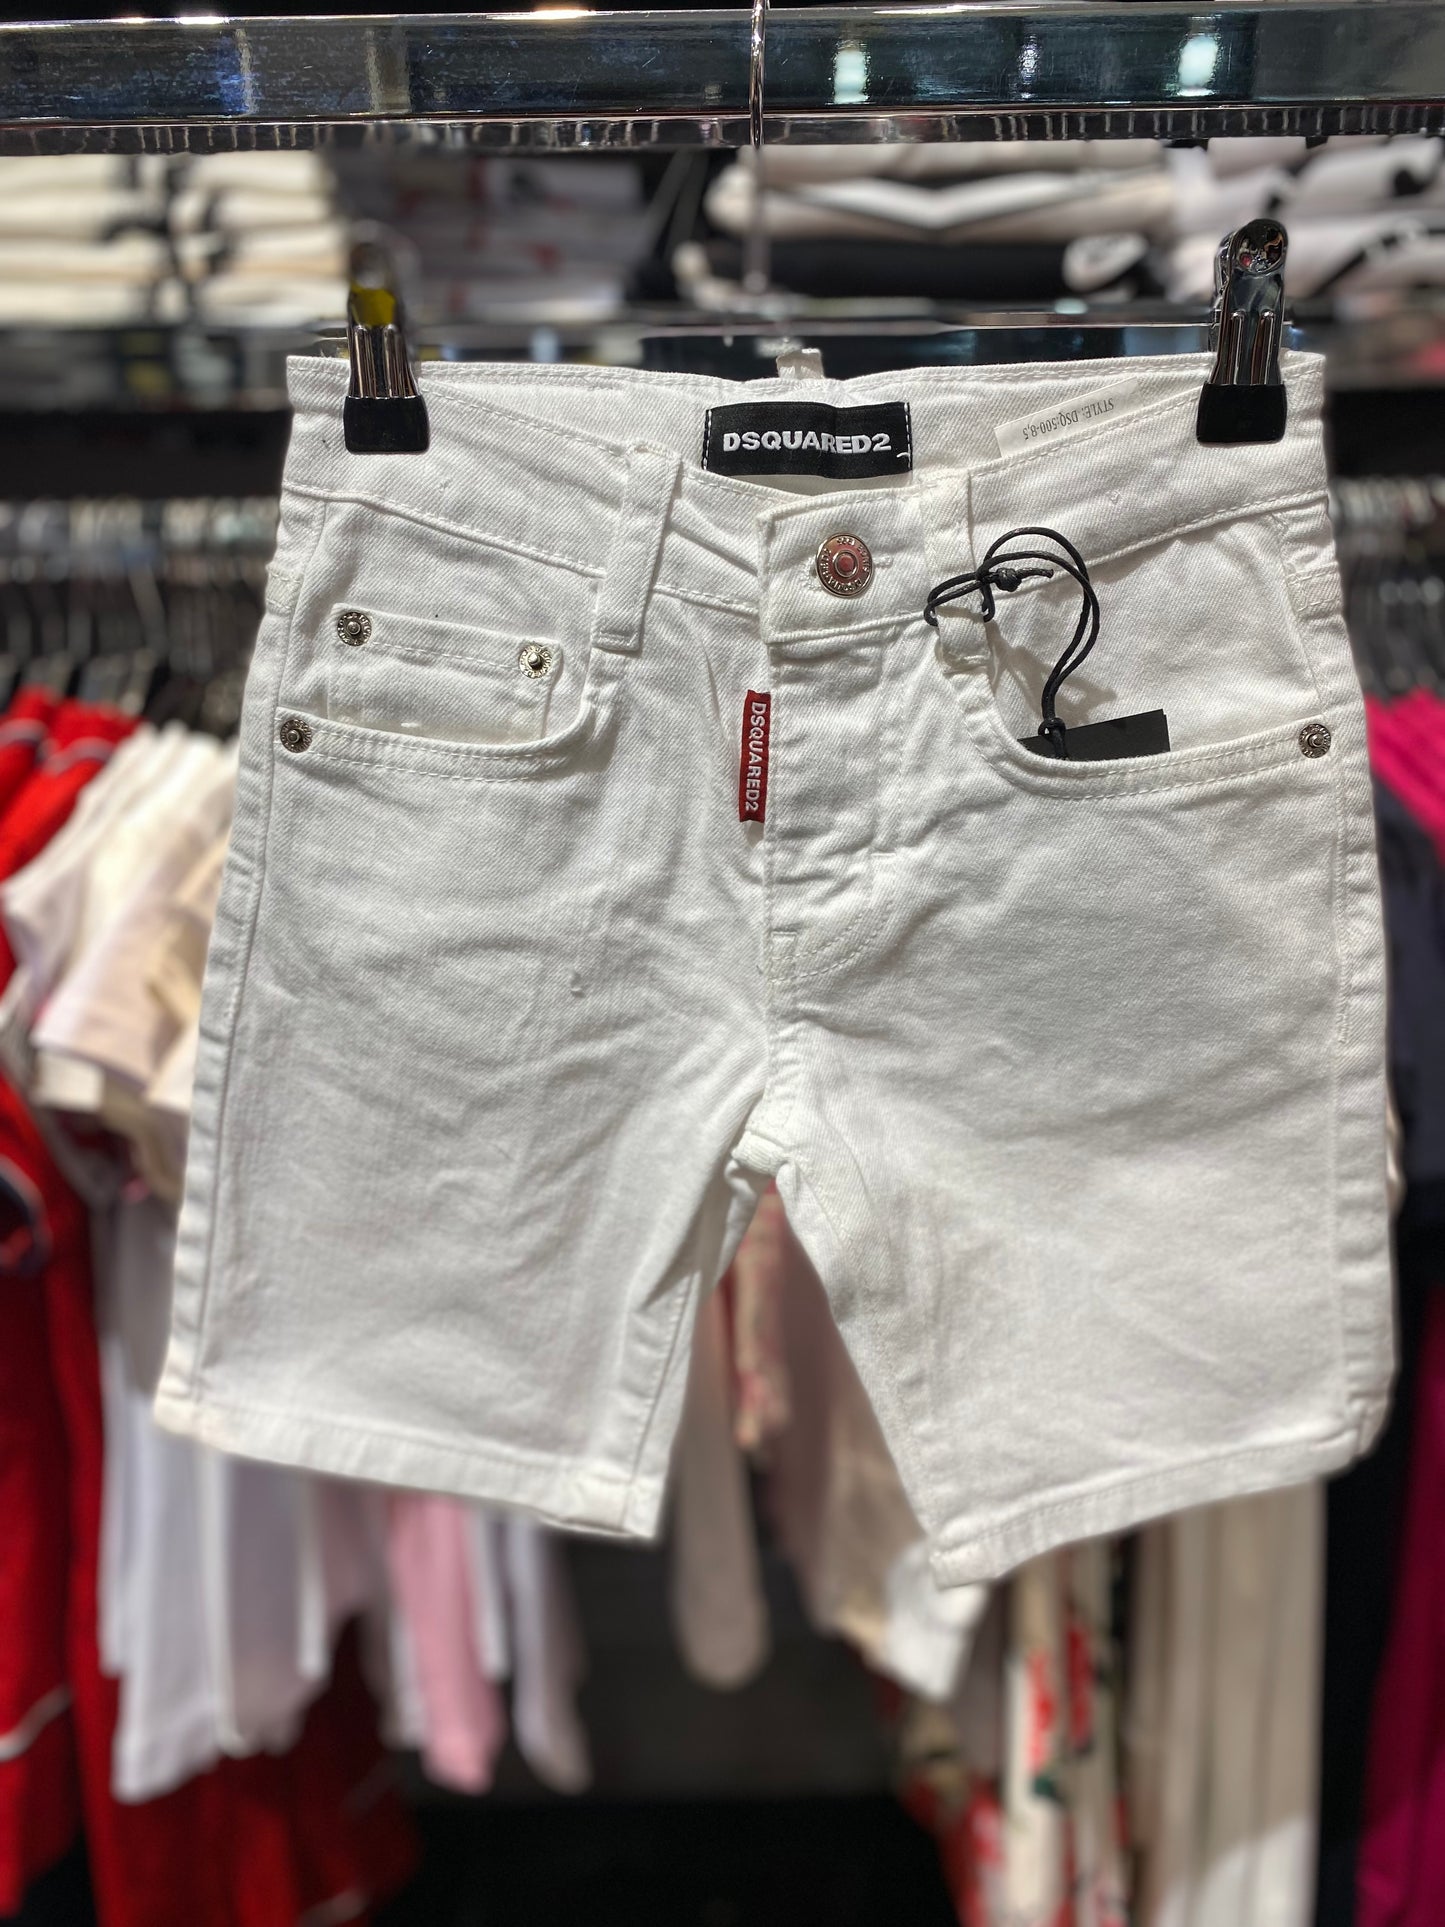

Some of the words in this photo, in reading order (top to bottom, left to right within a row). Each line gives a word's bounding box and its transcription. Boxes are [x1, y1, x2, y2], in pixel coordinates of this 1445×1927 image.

[1082, 398, 1115, 419] STYLE:
[723, 430, 892, 454] DSQUARED2
[745, 701, 767, 811] DSQUARED2
